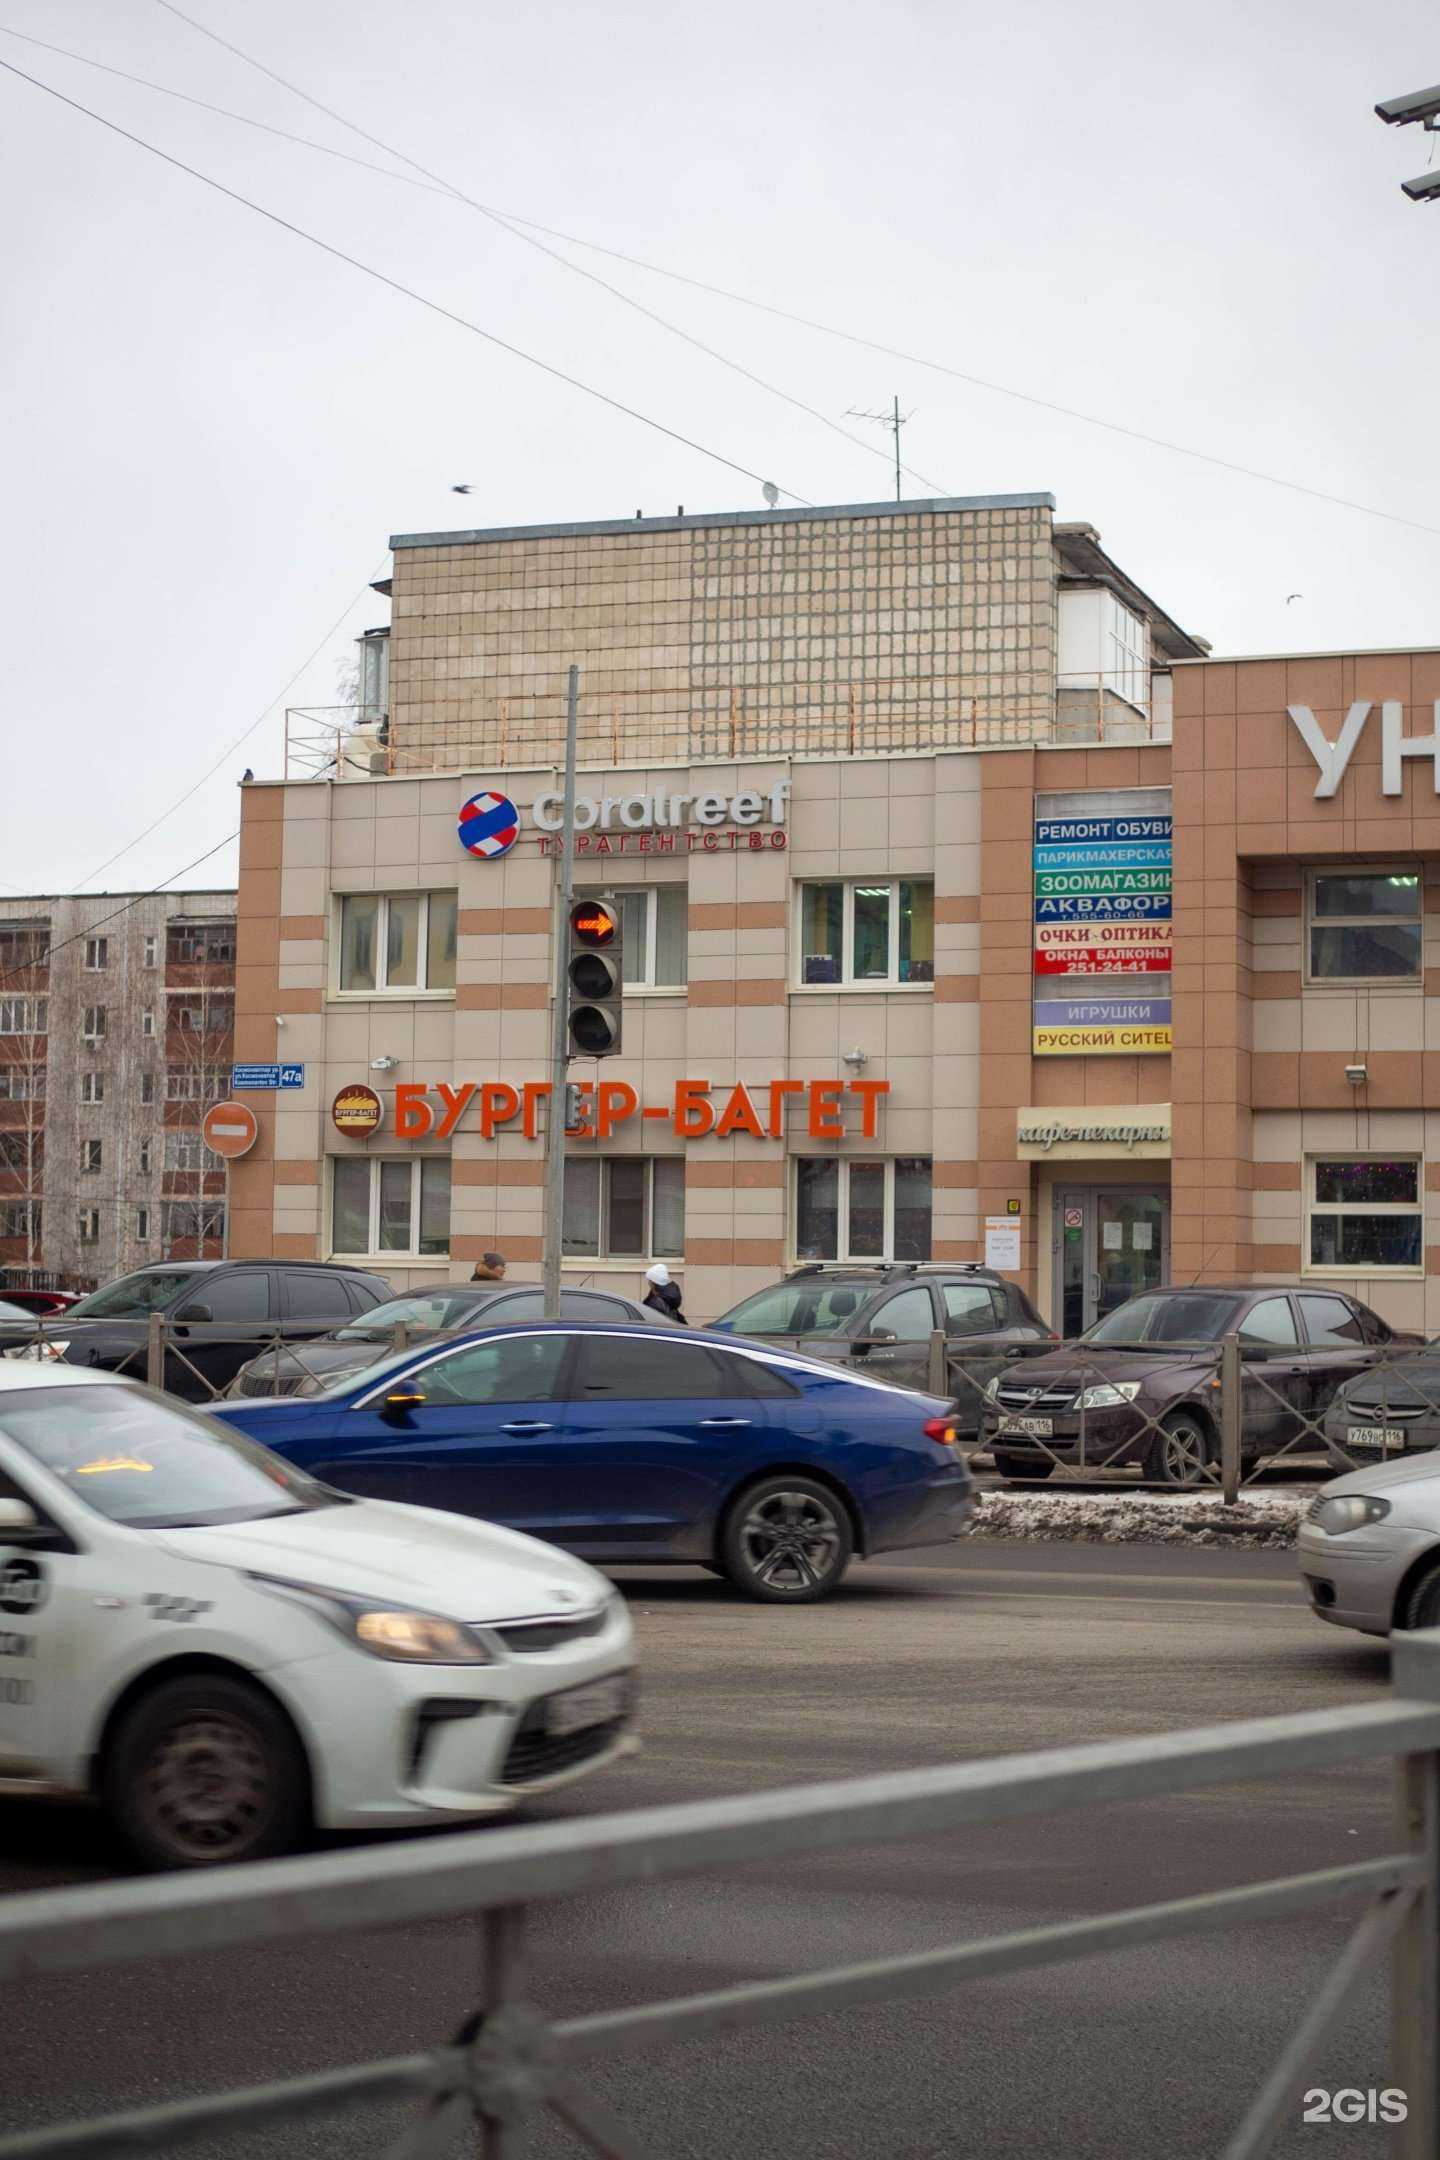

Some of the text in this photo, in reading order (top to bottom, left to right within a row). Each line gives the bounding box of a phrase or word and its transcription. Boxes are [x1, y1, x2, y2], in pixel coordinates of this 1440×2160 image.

[1287, 700, 1440, 798] УН
[1039, 823, 1112, 839] РЕМОНТ
[1038, 849, 1173, 864] ПАРИКМАХЕРСКАЯ
[1039, 896, 1169, 913] АКВАФОР
[1039, 929, 1090, 943] ОЧКИ
[1045, 948, 1169, 962] ОКНА БАЛКОНЫ
[1067, 961, 1148, 973] 251-24-41
[1068, 1006, 1150, 1019] ИГРУШКИ
[1038, 1031, 1115, 1047] РУССКИЙ
[282, 1070, 302, 1082] 47а
[1018, 1120, 1170, 1151] кафе-пекарня
